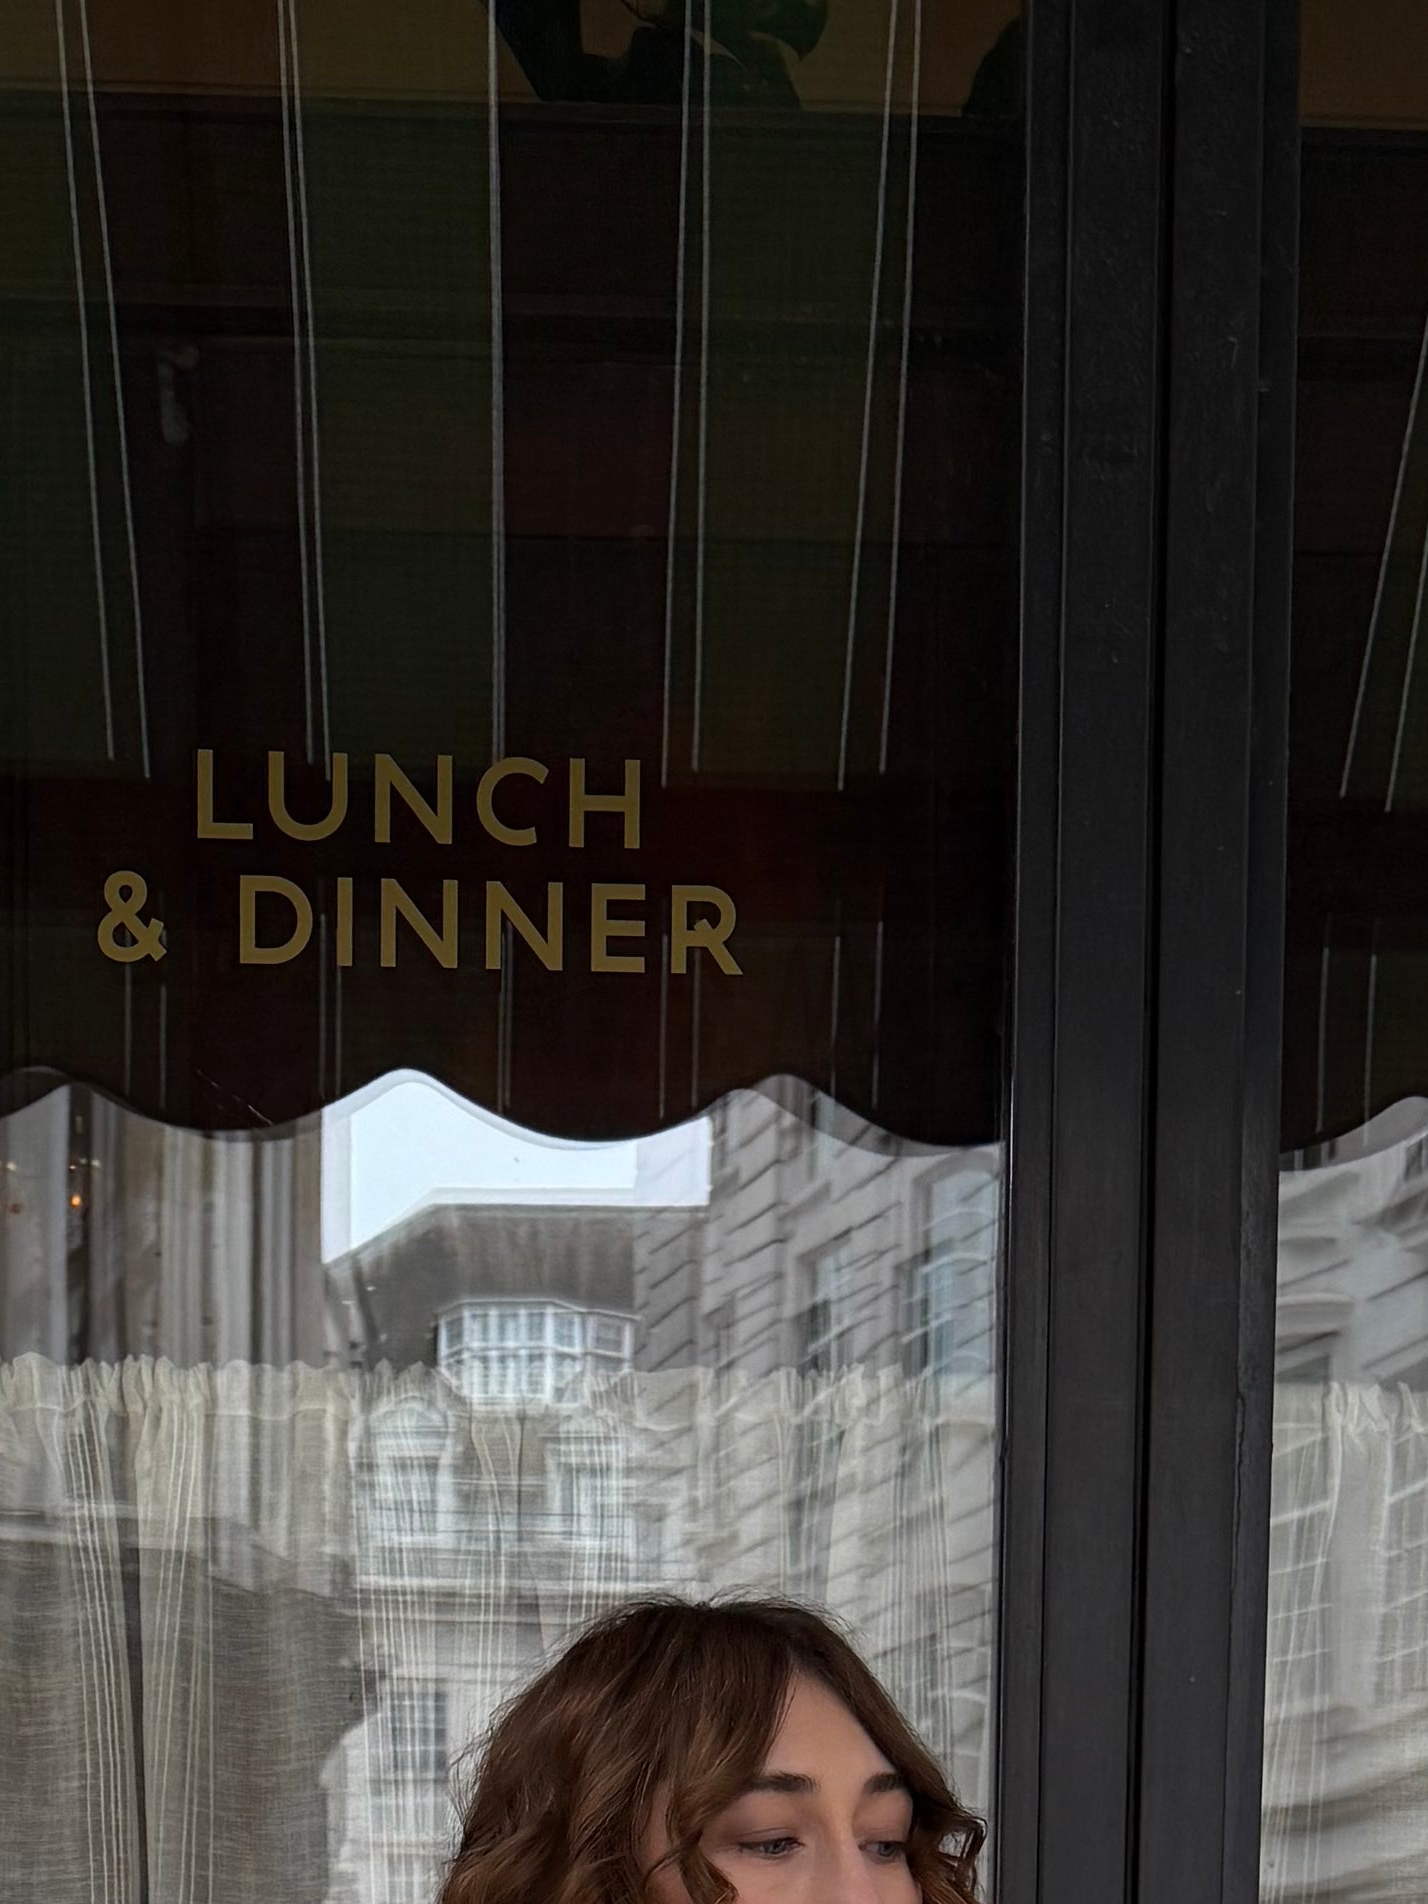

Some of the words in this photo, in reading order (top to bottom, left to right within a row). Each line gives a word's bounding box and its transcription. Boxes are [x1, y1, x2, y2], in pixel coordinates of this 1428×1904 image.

[197, 748, 640, 849] LUNCH
[97, 870, 167, 963] &
[239, 874, 744, 975] DINNER
